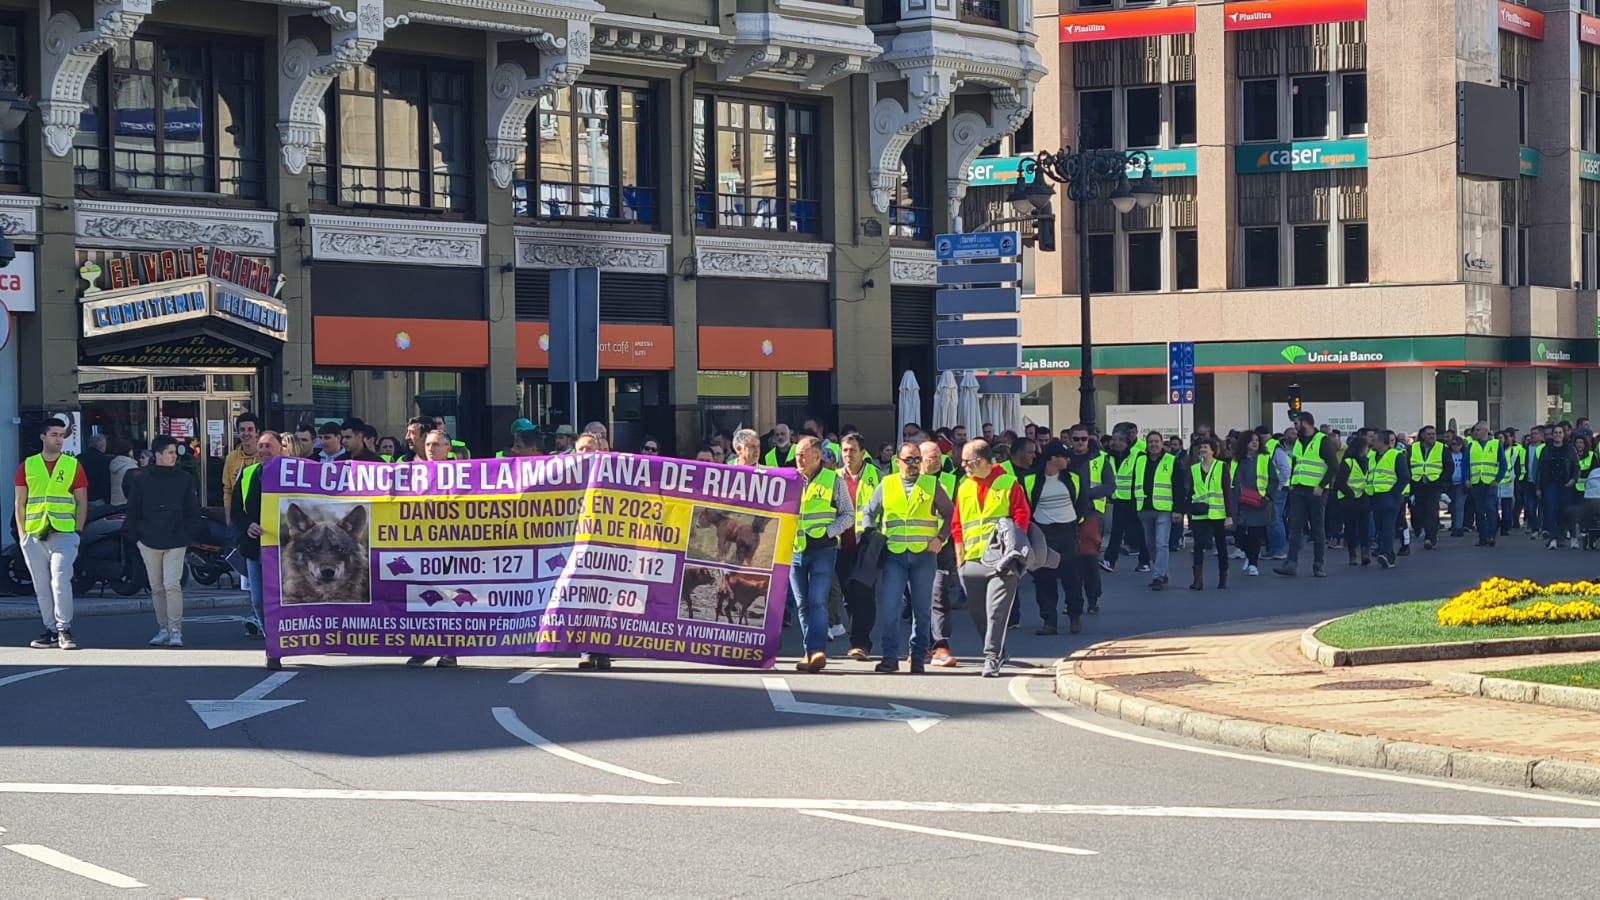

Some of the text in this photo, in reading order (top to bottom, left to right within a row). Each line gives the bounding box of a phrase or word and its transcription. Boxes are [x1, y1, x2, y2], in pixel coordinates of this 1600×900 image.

[1238, 12, 1272, 21] PlusUltra
[1074, 24, 1106, 33] PlusUltra
[1269, 148, 1355, 167] caser seguros
[0, 274, 21, 291] ca
[109, 258, 139, 290] EL
[96, 290, 288, 332] CONFITERIA HELADERIA
[144, 346, 237, 356] VALENCIANO
[190, 337, 205, 345] EL
[99, 355, 261, 365] HELADERIA CAFE-BAR
[1040, 359, 1070, 369] Banco
[1308, 350, 1383, 363] Unicaja Banco
[279, 452, 787, 507] EL CÁNCER DE LA MONTAÑA DE RIAÑO
[400, 495, 663, 520] DAÑOS OCASIONADOS EN 2023
[378, 516, 681, 545] EN LA GANADERÍA (MONTAÑA DE RIAÑO)
[420, 555, 523, 576] BOVINO: 127
[575, 551, 664, 577] EQUINO: 112
[488, 585, 637, 608] OVINO Y CAPRINO: 60
[278, 614, 322, 633] ADEMÁS
[325, 617, 340, 631] DE
[341, 617, 397, 631] ANIMALES
[399, 617, 462, 631] SILVESTRES
[465, 618, 487, 631] CON
[489, 615, 537, 631] PÉRDIDAS
[539, 614, 565, 627] PARA
[583, 616, 617, 631] JUNTAS
[620, 617, 675, 636] VECINALES
[677, 624, 684, 637] Y
[685, 624, 766, 647] AYUNTAMIENTO
[279, 634, 321, 649] ESTO
[325, 631, 342, 647] SÍ
[346, 633, 379, 648] QUE
[385, 634, 406, 647] ES
[409, 632, 497, 648] MALTRATO
[500, 630, 561, 646] ANIMAL
[566, 630, 575, 643] Y
[589, 631, 612, 645] NO
[615, 635, 686, 653] JUZGUEN
[690, 640, 764, 661] USTEDES
